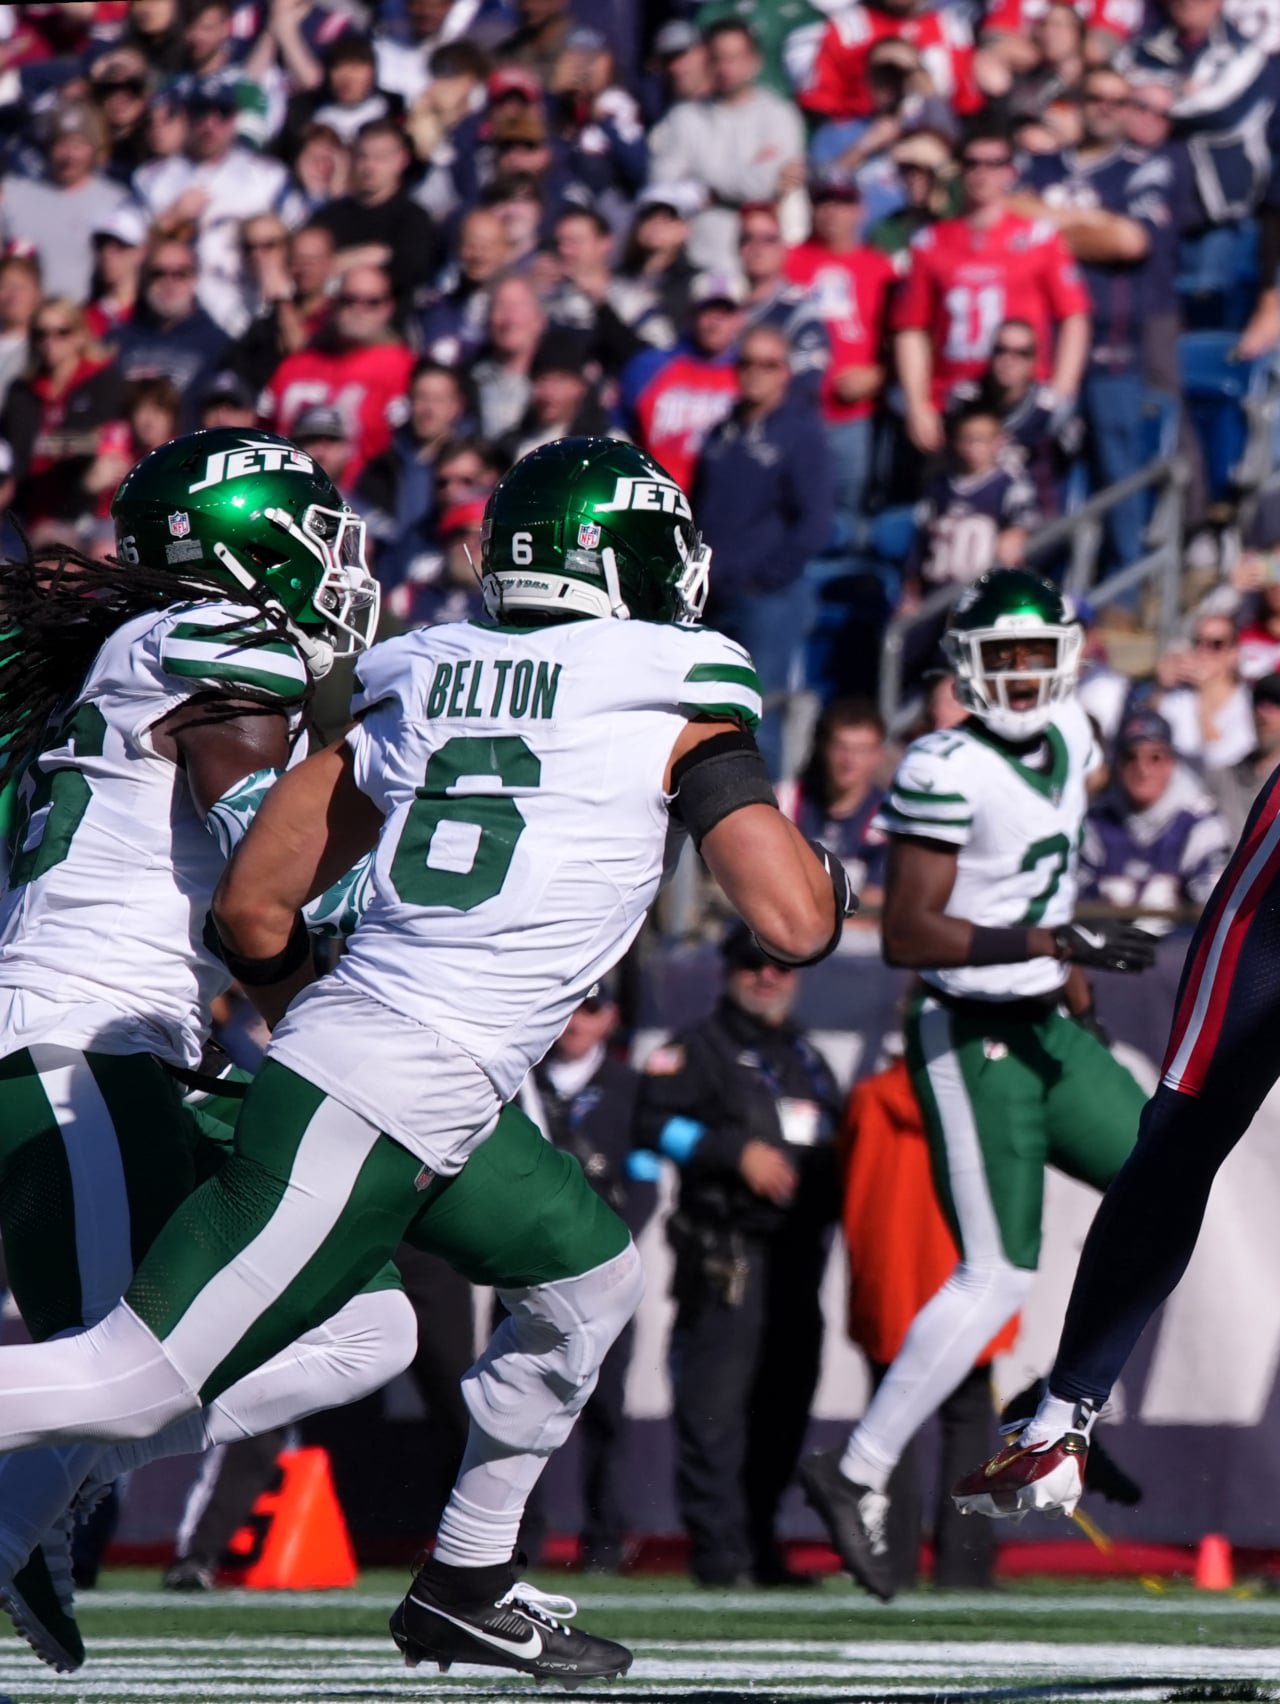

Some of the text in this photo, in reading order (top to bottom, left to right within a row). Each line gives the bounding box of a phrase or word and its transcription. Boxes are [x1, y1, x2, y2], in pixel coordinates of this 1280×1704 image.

[188, 438, 314, 495] JETS
[593, 464, 693, 521] JETS
[512, 531, 533, 566] 6
[426, 659, 563, 720] BELTON
[390, 735, 542, 913] 6
